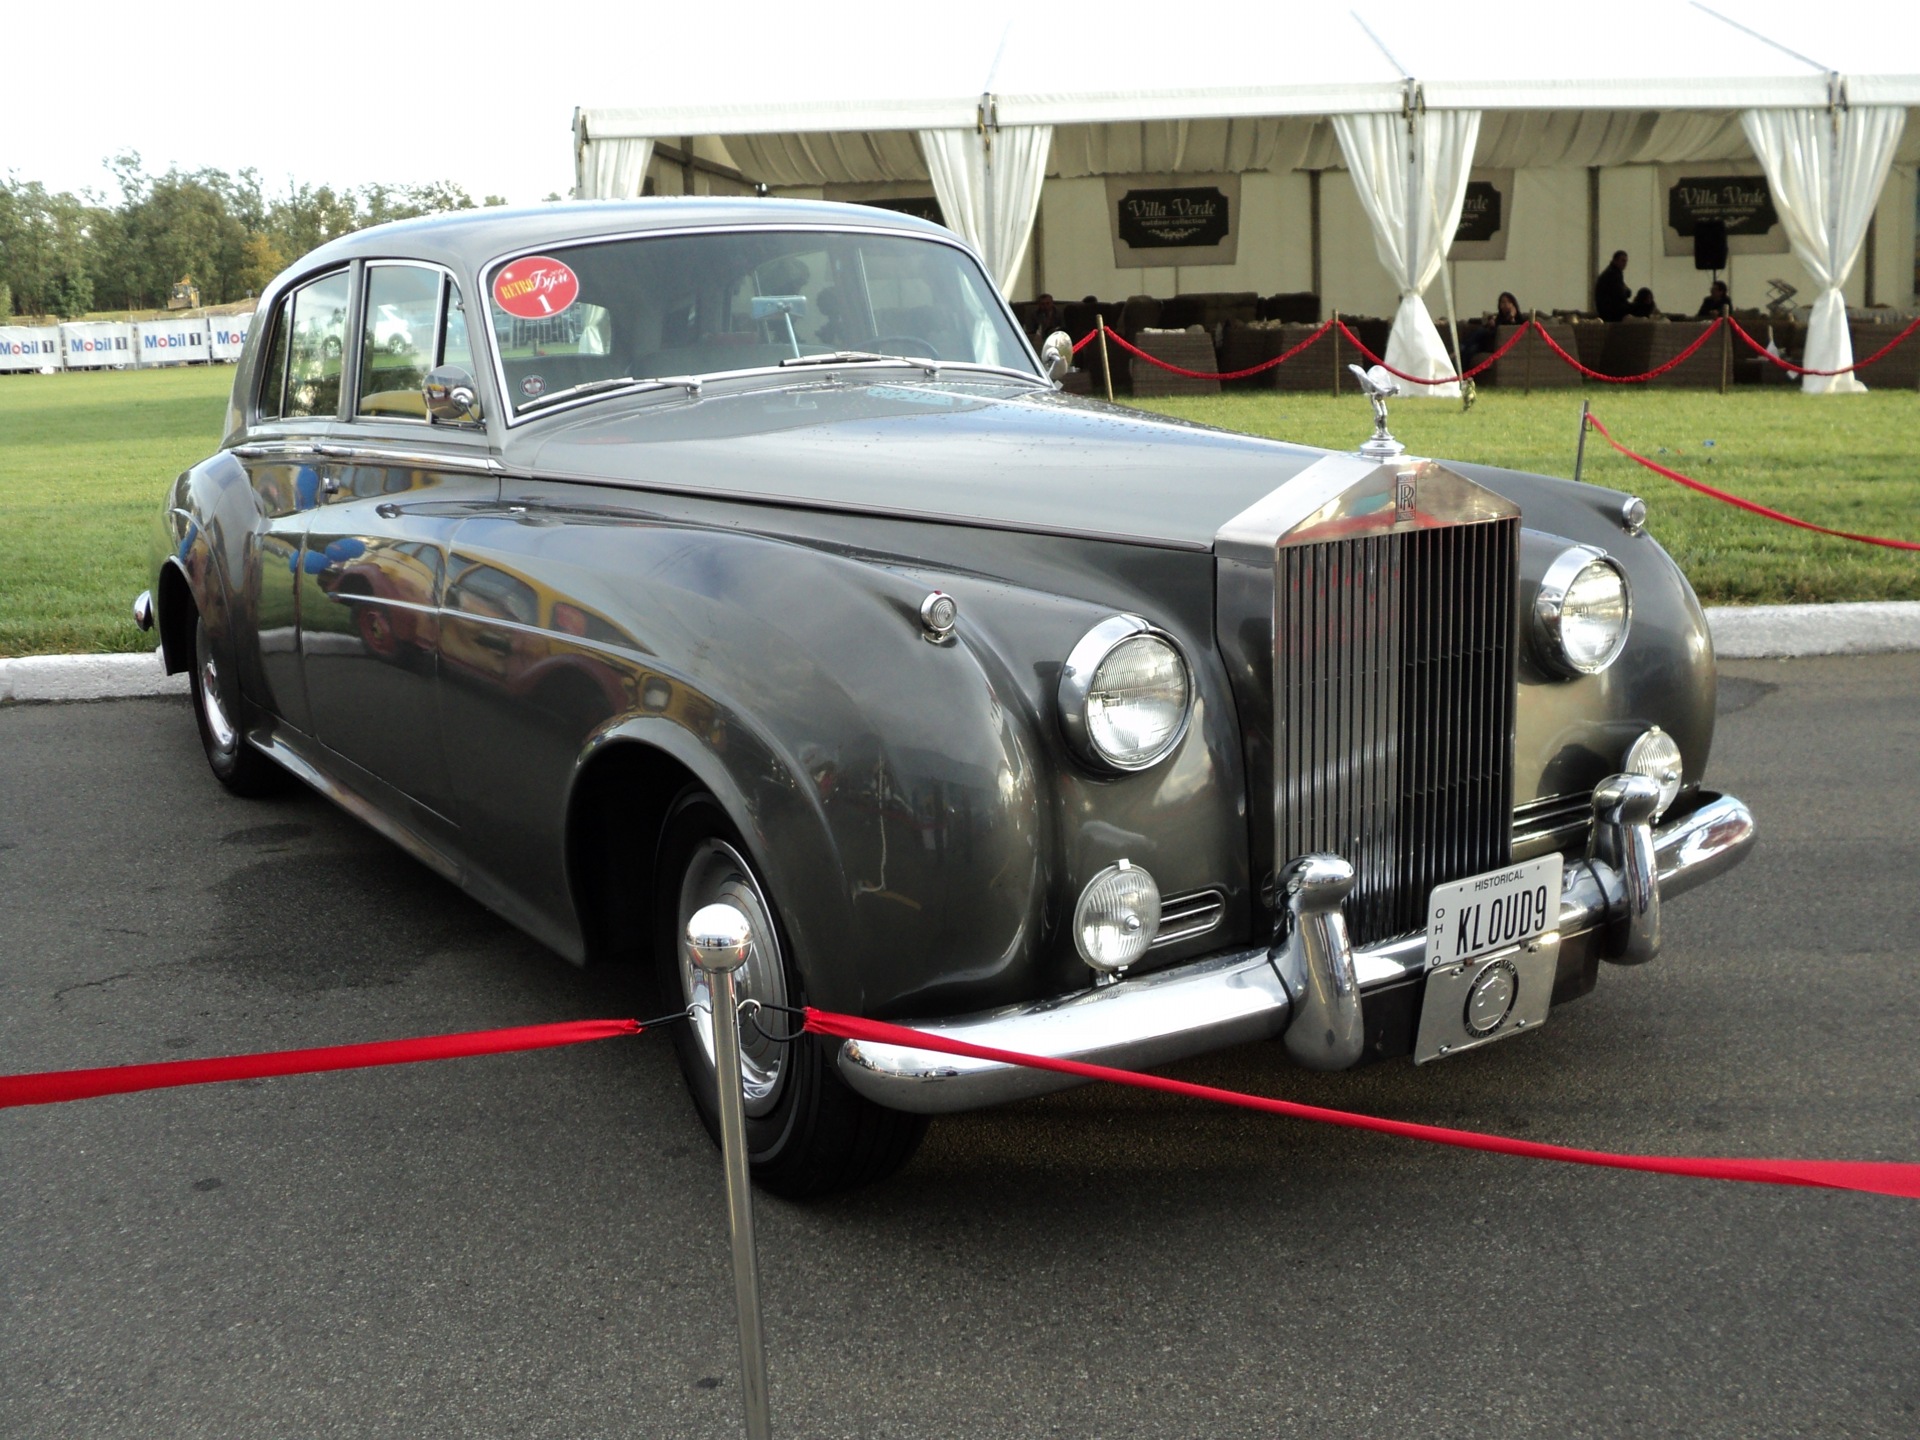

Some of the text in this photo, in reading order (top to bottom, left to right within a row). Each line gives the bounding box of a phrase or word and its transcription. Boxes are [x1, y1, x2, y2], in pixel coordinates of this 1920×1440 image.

[1679, 186, 1766, 205] Villa Verde
[1127, 198, 1217, 217] Villa Verde
[1171, 217, 1207, 225] collection
[537, 294, 554, 313] 1
[42, 339, 54, 353] 1
[71, 336, 127, 352] Mobil 1
[144, 332, 202, 348] Mobil 1
[217, 330, 247, 345] Mob
[1474, 869, 1525, 892] HISTORICAL
[1456, 885, 1547, 956] KLOUD9
[1431, 908, 1446, 967] OHIO
